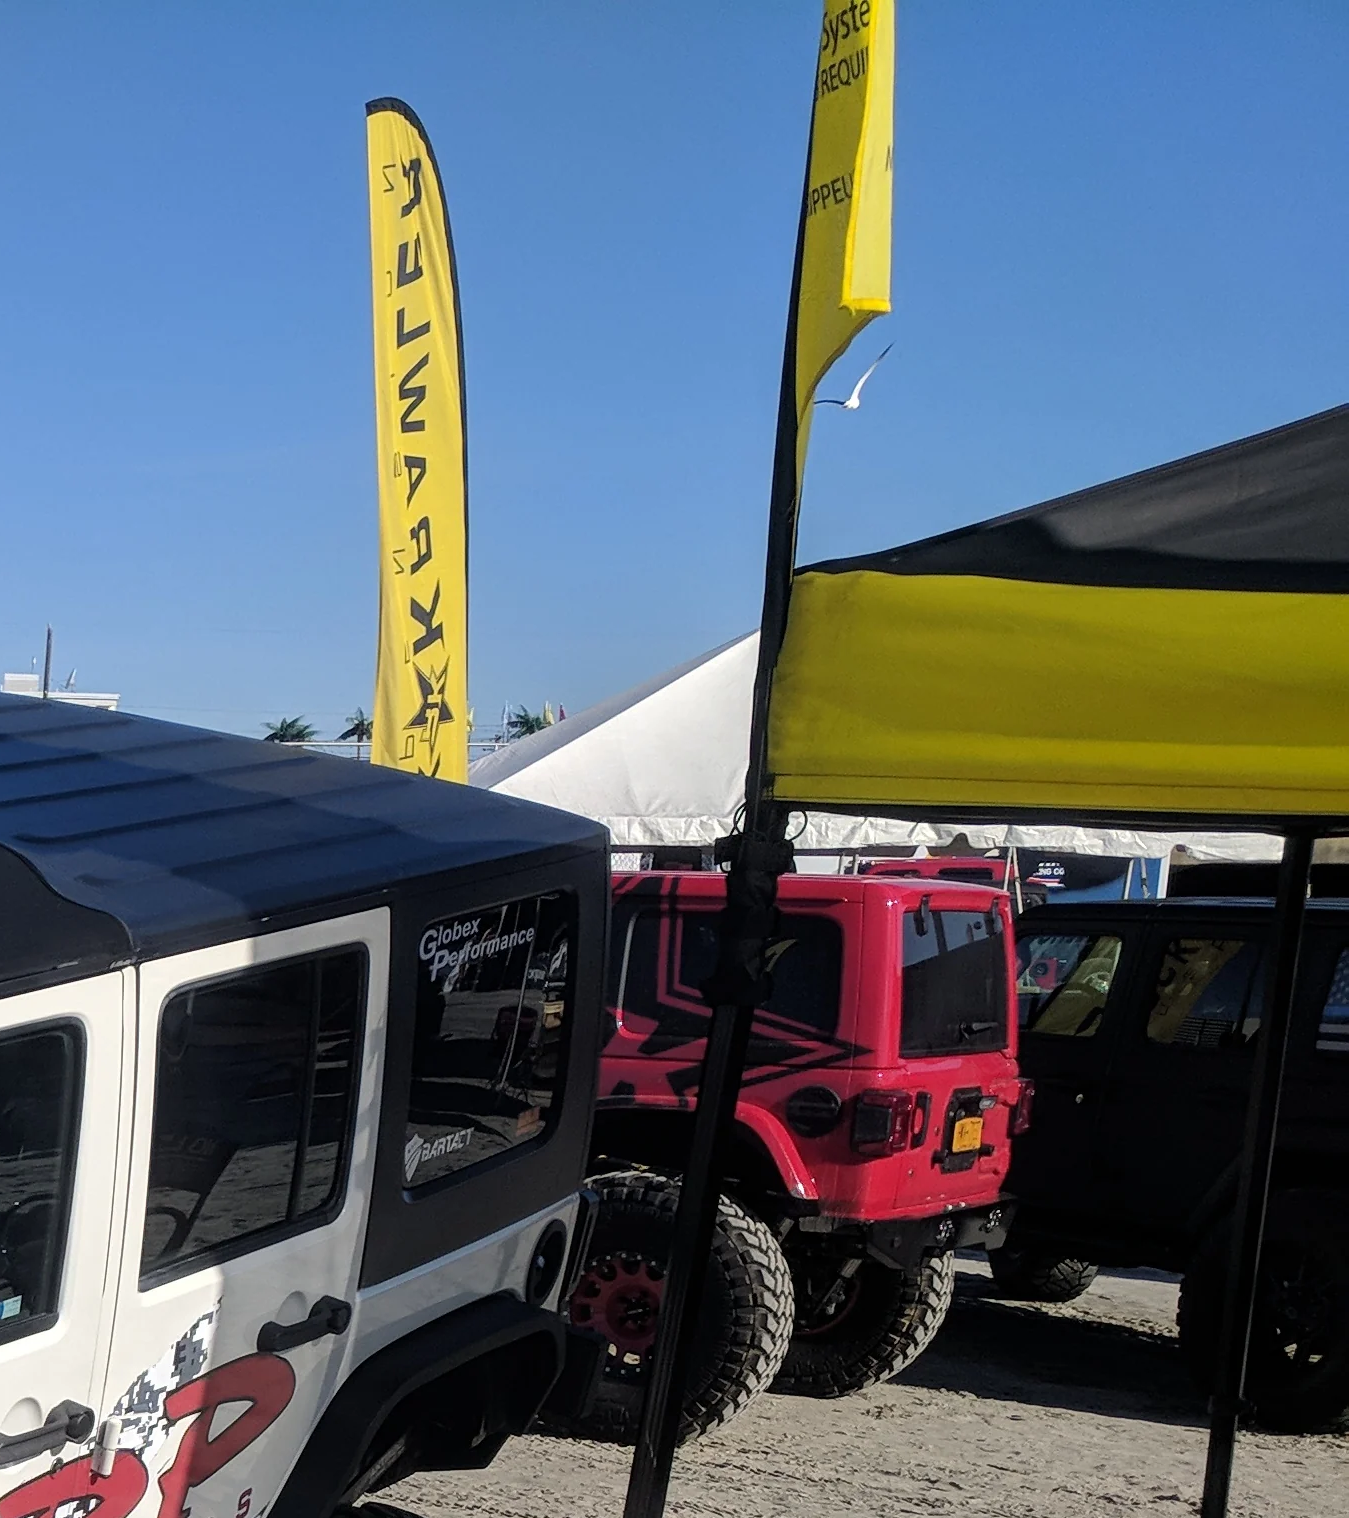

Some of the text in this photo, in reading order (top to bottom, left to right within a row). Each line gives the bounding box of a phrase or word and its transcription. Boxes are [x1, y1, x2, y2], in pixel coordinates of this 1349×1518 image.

[821, 46, 869, 97] REQUI
[419, 917, 482, 961] Globex
[429, 927, 535, 982] Performance
